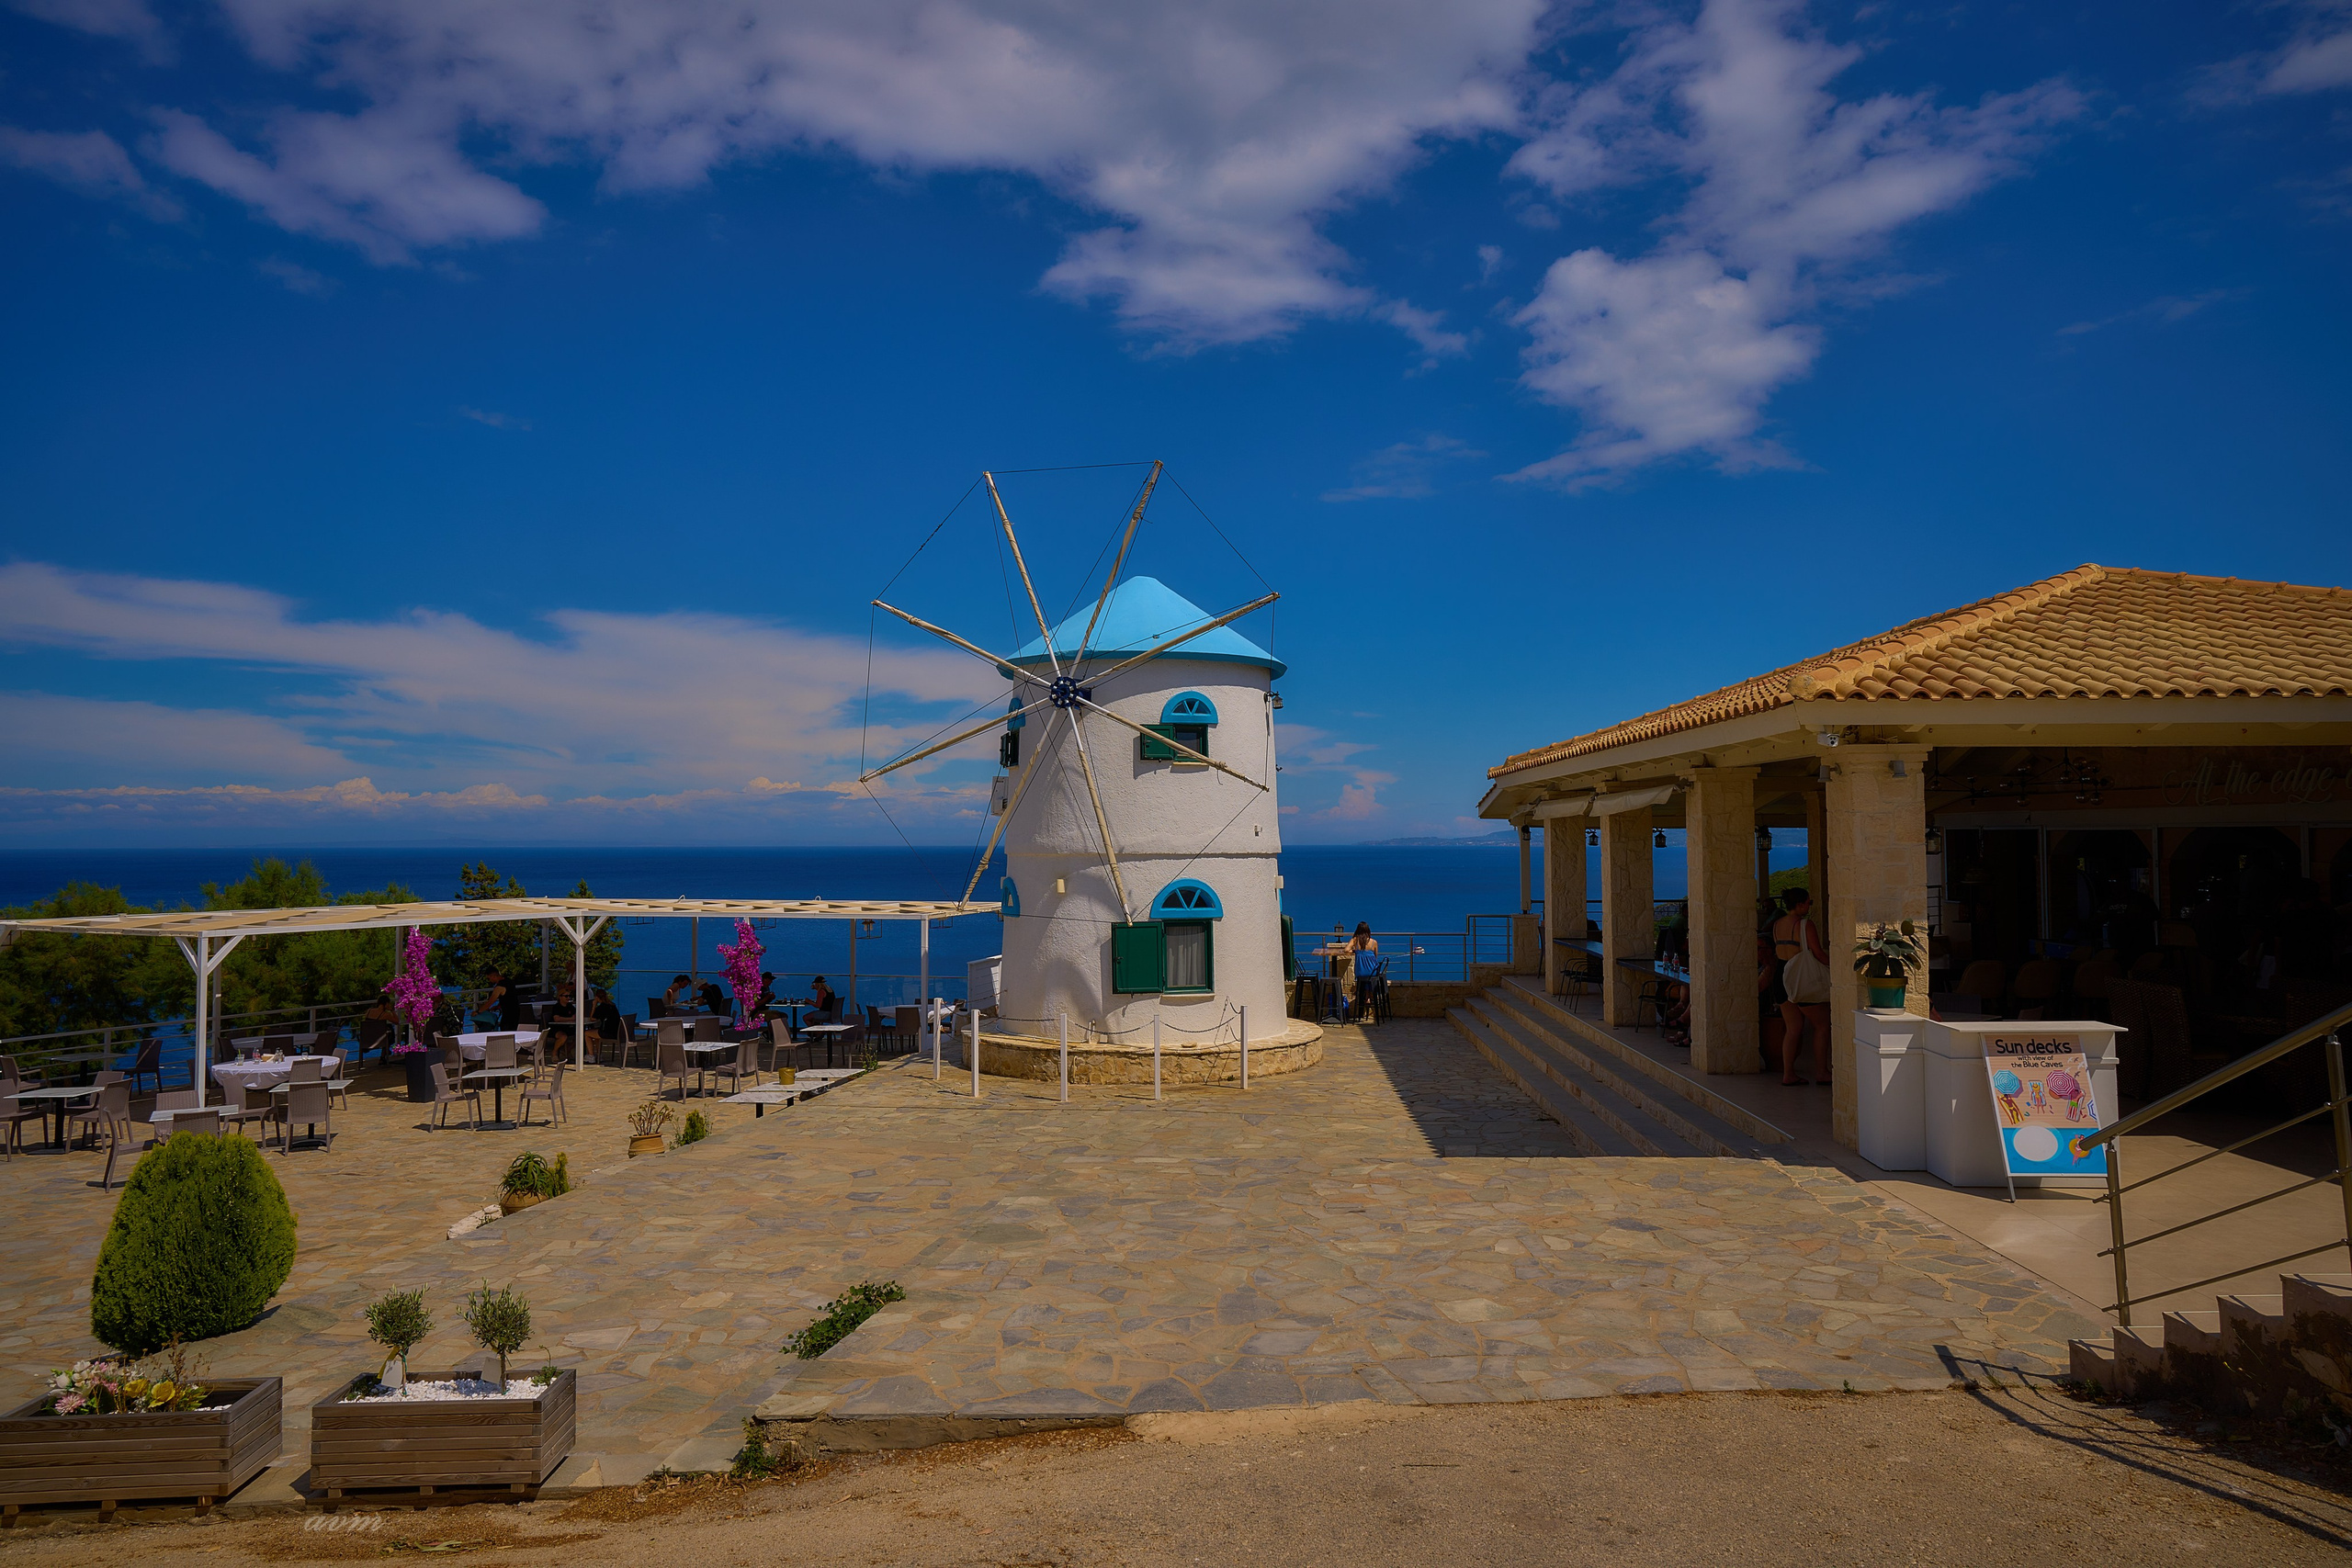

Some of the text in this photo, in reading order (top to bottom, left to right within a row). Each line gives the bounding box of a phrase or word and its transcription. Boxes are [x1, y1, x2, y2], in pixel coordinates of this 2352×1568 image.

[2162, 757, 2231, 807] At
[2223, 760, 2264, 795] the
[2270, 755, 2338, 805] edge
[1995, 1038, 2073, 1054] Sun decks
